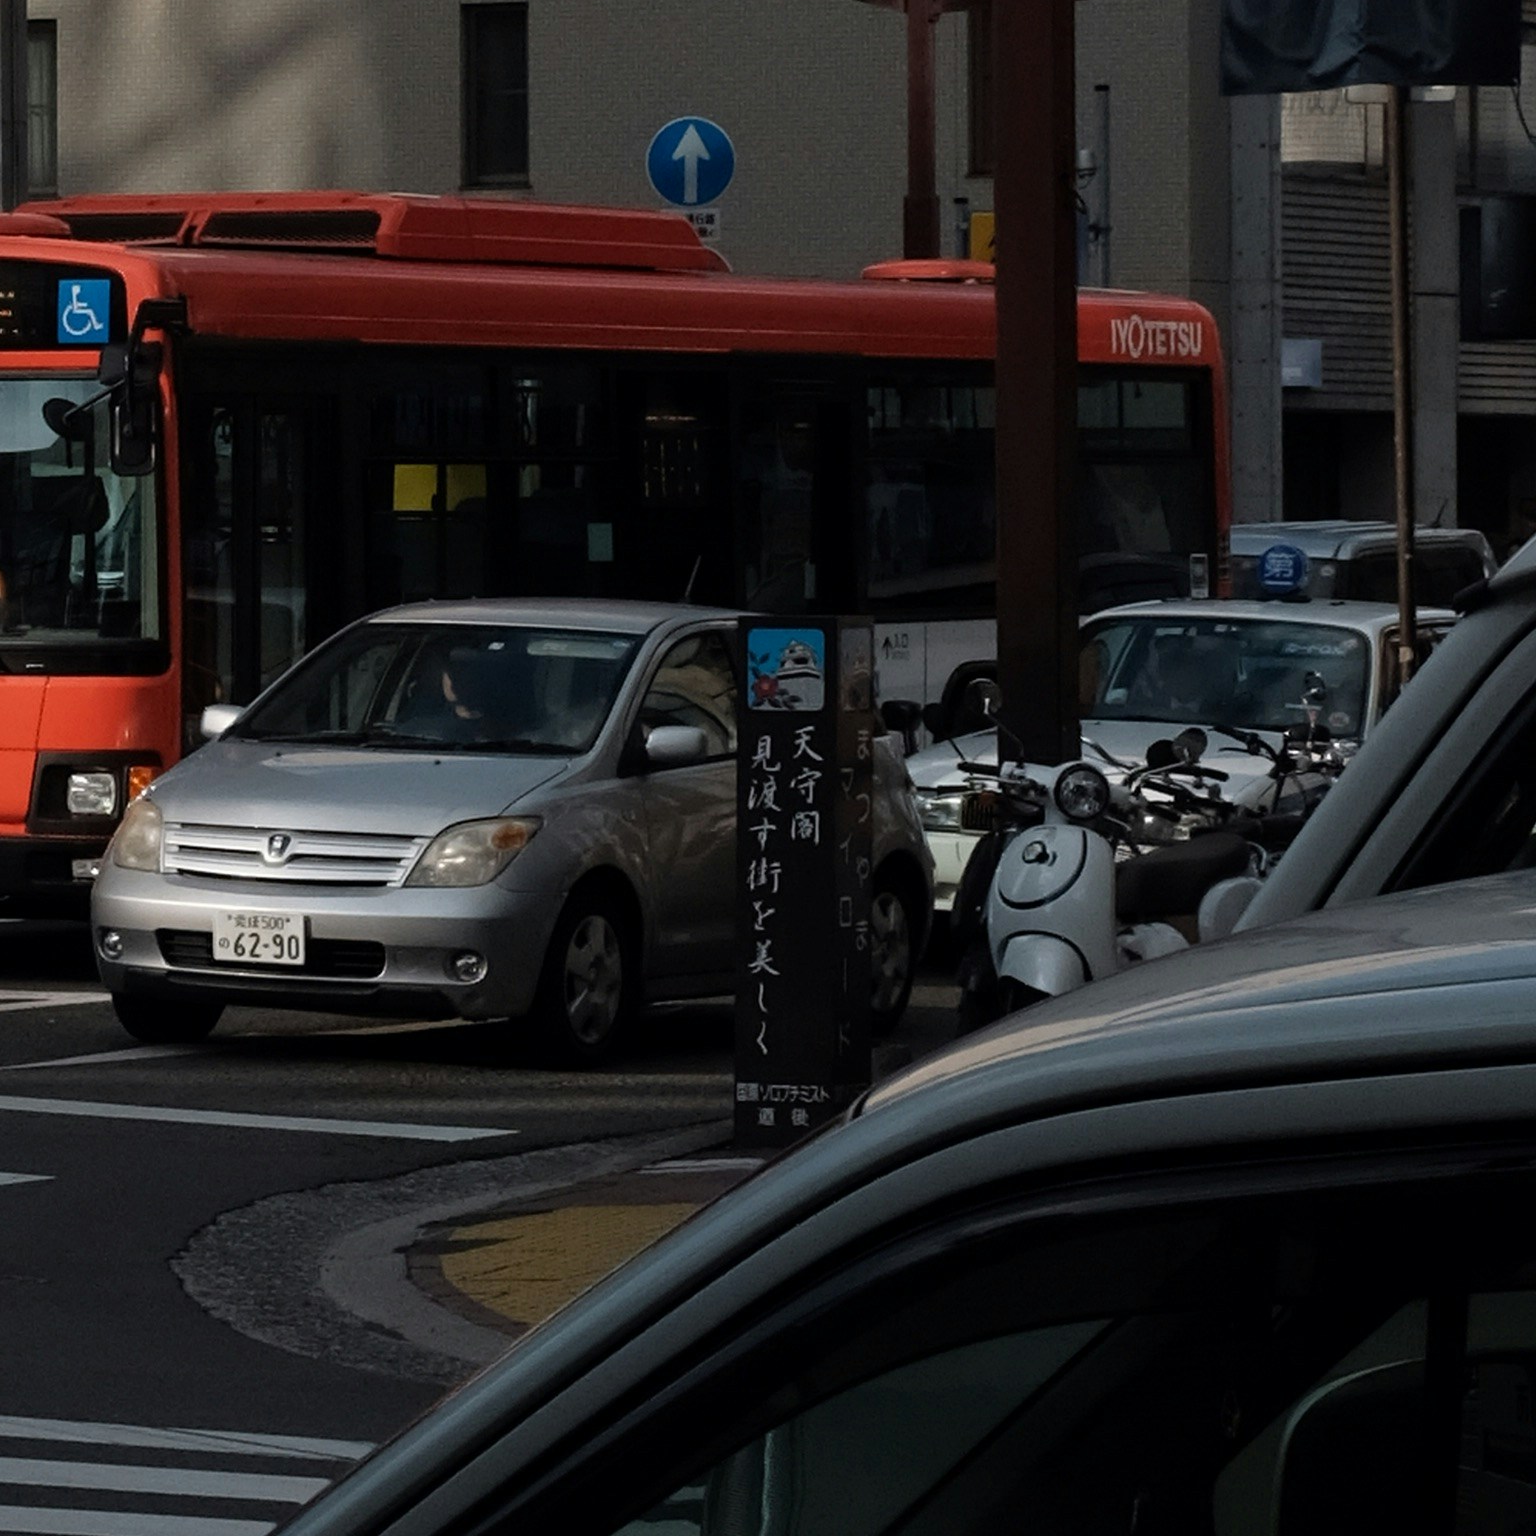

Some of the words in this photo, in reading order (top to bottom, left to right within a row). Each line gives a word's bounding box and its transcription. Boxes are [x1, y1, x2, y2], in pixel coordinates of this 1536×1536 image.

[1111, 314, 1202, 358] IYOTETSU
[789, 725, 825, 846] 天守閣
[746, 734, 783, 1056] 見渡す街を美しく
